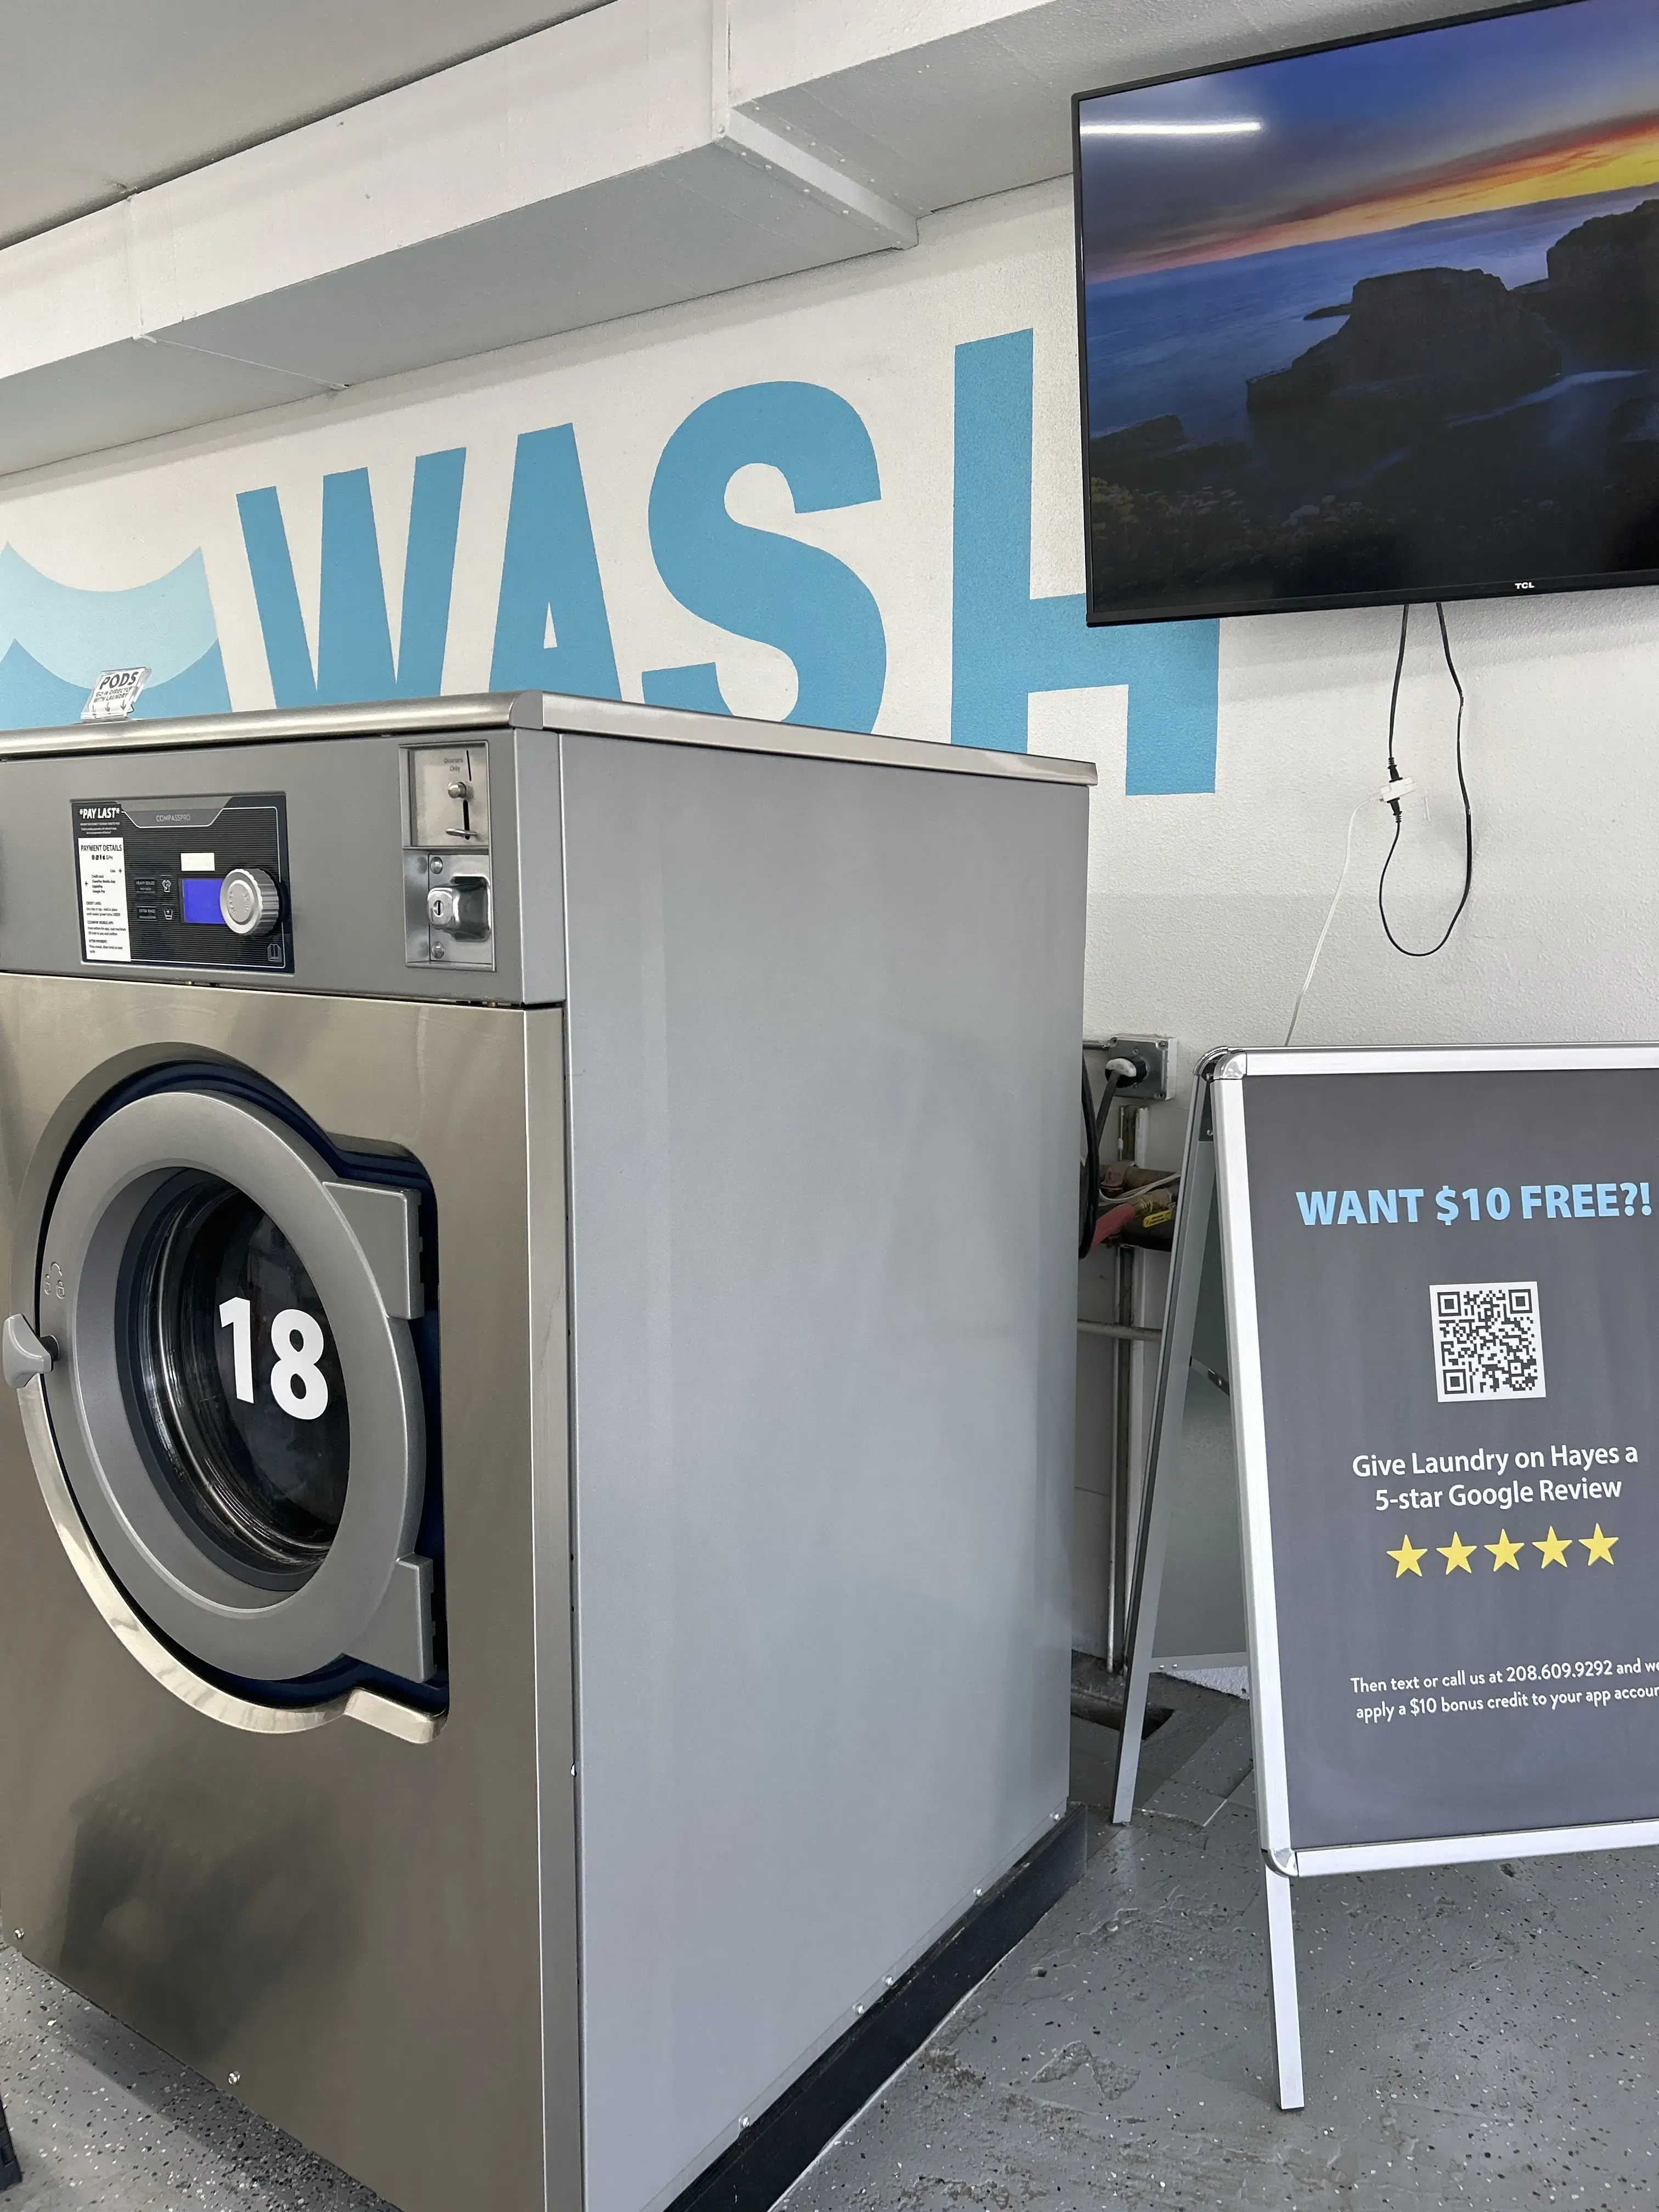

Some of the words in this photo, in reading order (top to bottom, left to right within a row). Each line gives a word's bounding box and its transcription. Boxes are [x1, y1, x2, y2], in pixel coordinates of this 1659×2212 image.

[236, 328, 1220, 795] WASH
[99, 672, 139, 690] PODS
[1295, 1188, 1424, 1226] WANT
[1435, 1185, 1510, 1226] $10
[1520, 1182, 1652, 1219] FREE?!
[219, 1296, 329, 1420] 18
[1352, 1454, 1406, 1477] Give
[1412, 1448, 1509, 1476] Laundry
[1515, 1451, 1545, 1469] on
[1550, 1444, 1620, 1471] Hayes
[1625, 1446, 1639, 1463] a
[1375, 1488, 1443, 1511] 5-star
[1448, 1480, 1533, 1510] Google
[1539, 1477, 1622, 1502] Review
[1350, 1677, 1387, 1693] Then
[1390, 1676, 1420, 1690] text
[1423, 1677, 1439, 1688] or
[1442, 1669, 1466, 1687] call
[1469, 1674, 1486, 1685] us
[1488, 1671, 1503, 1684] at
[1506, 1660, 1613, 1682] 208.609.9292
[1616, 1657, 1641, 1675] and
[1356, 1700, 1395, 1724] apply
[1398, 1705, 1407, 1716] a
[1409, 1697, 1437, 1717] $10
[1441, 1696, 1484, 1712] bonus
[1487, 1691, 1529, 1711] credit
[1531, 1693, 1547, 1706] to
[1549, 1692, 1583, 1711] your
[1585, 1690, 1611, 1707] app
